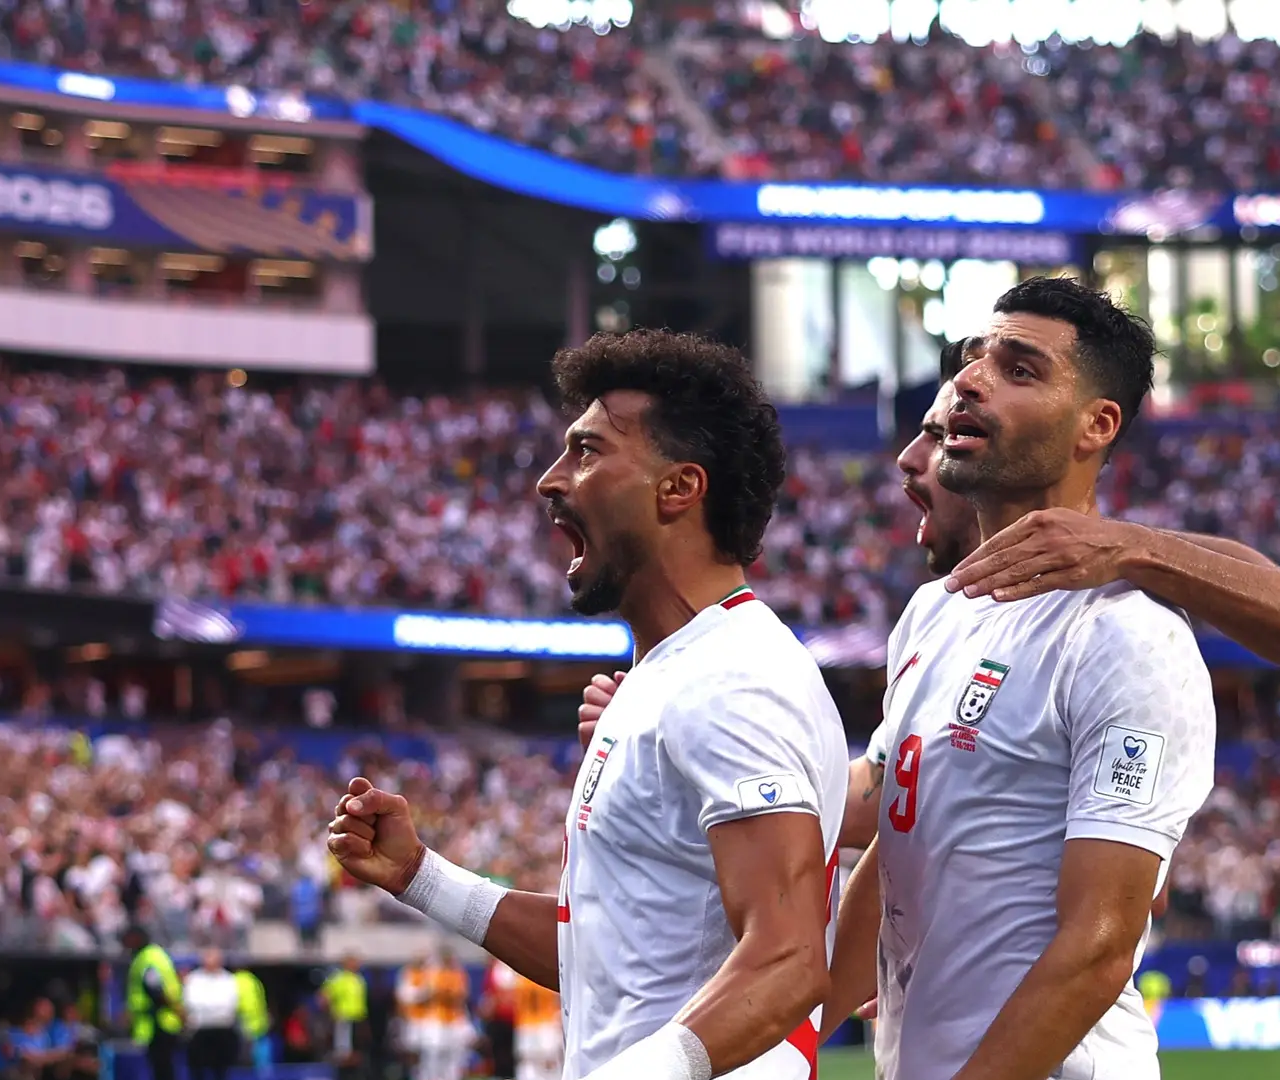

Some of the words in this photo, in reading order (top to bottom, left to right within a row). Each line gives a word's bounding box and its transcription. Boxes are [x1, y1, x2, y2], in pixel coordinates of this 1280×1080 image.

[1111, 758, 1135, 772] Unite
[1135, 762, 1148, 775] For
[888, 733, 923, 834] 9
[1111, 771, 1143, 789] PEACE
[1114, 786, 1132, 796] FIFA
